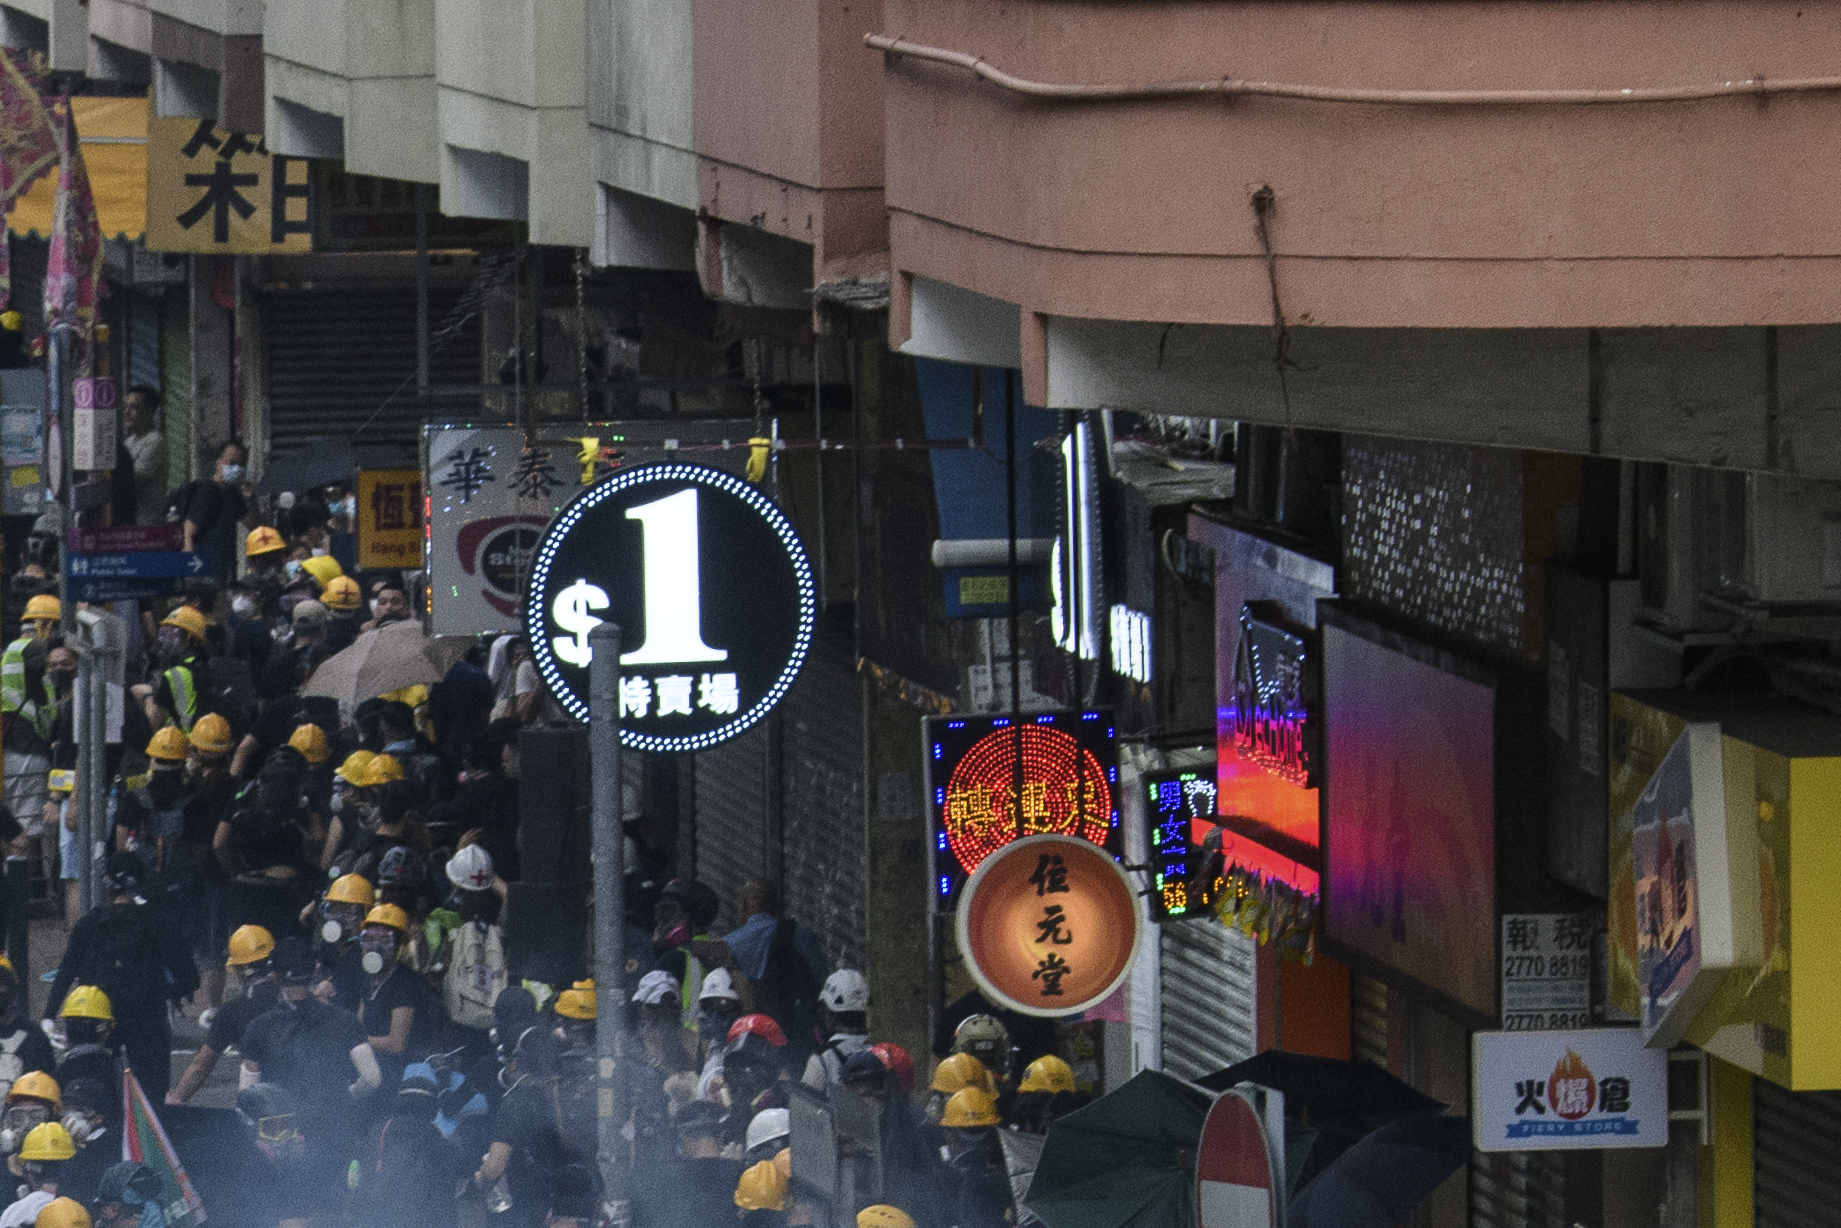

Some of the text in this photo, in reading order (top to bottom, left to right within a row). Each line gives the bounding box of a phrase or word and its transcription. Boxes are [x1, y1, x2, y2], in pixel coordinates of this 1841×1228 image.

[440, 444, 628, 502] 華泰
[619, 672, 741, 718] 特賣場
[1028, 853, 1073, 997] 位元堂
[1506, 917, 1589, 952] 報稅
[1505, 954, 1589, 978] 2770 8819
[1514, 1076, 1632, 1116] 火爆倉
